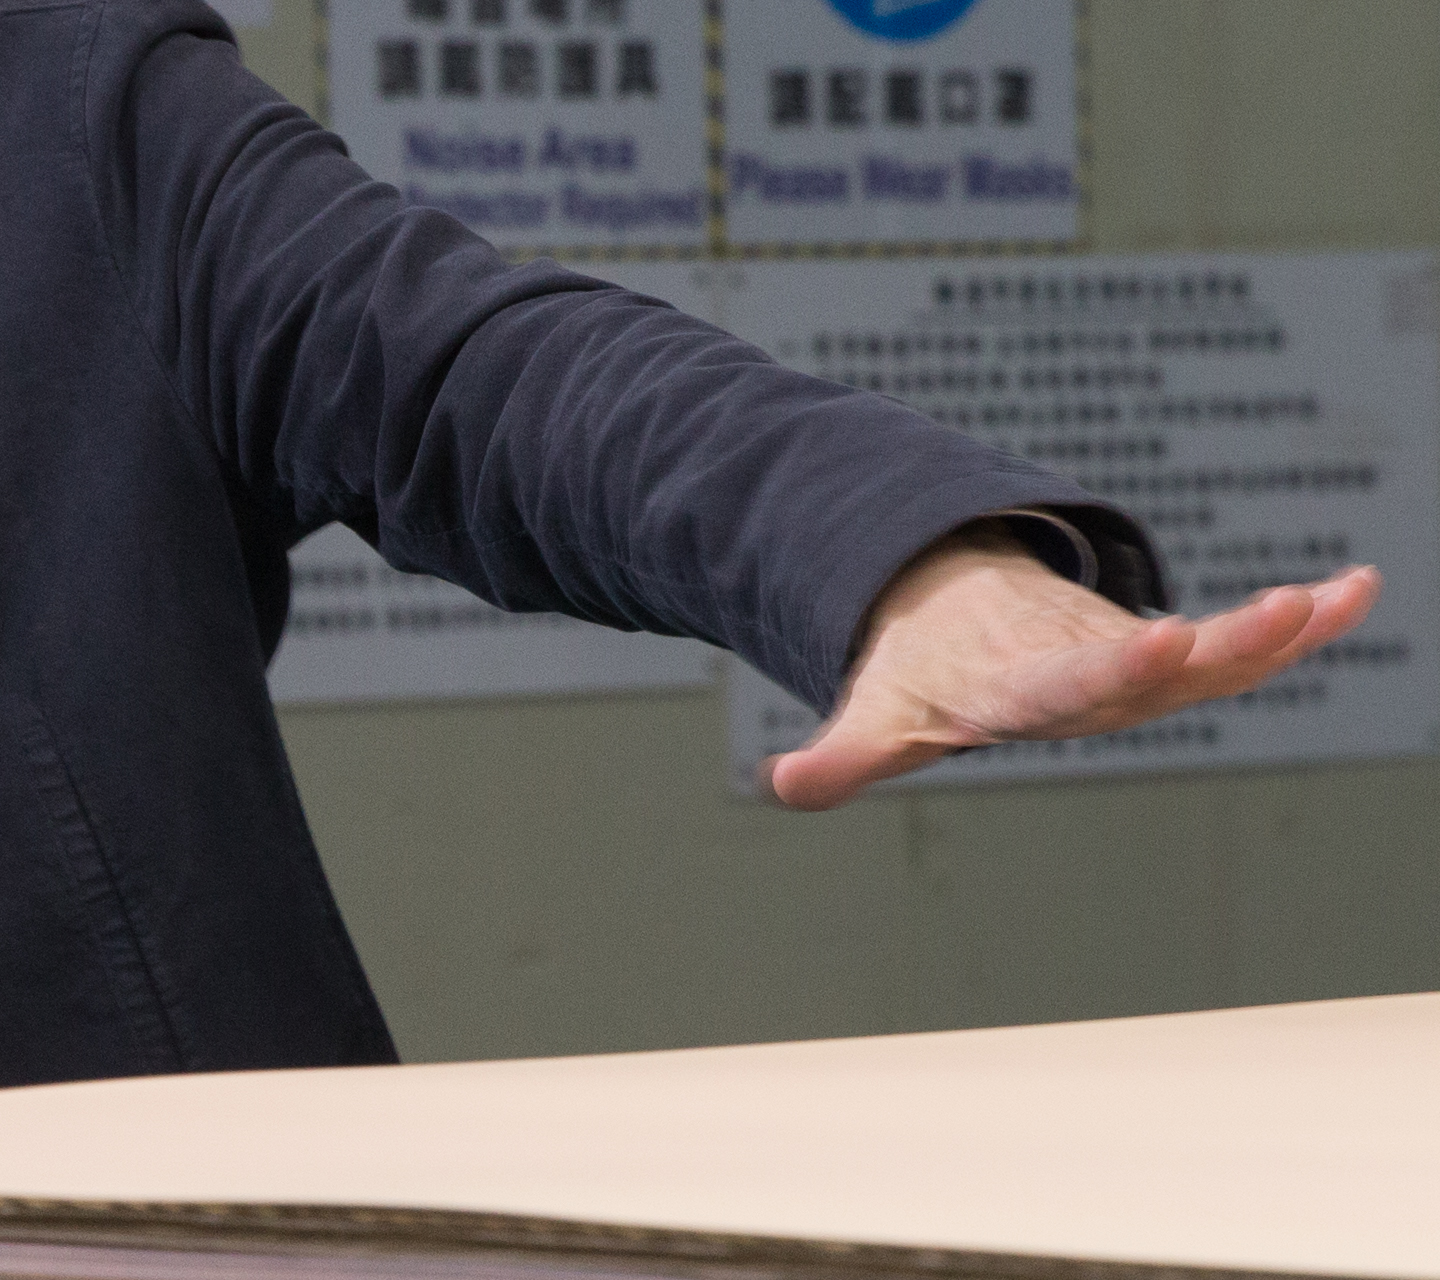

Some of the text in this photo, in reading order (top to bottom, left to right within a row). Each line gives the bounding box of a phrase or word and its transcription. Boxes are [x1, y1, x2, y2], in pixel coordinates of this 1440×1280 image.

[404, 126, 637, 172] Noise Area
[731, 156, 1072, 202] Please Wear Masks
